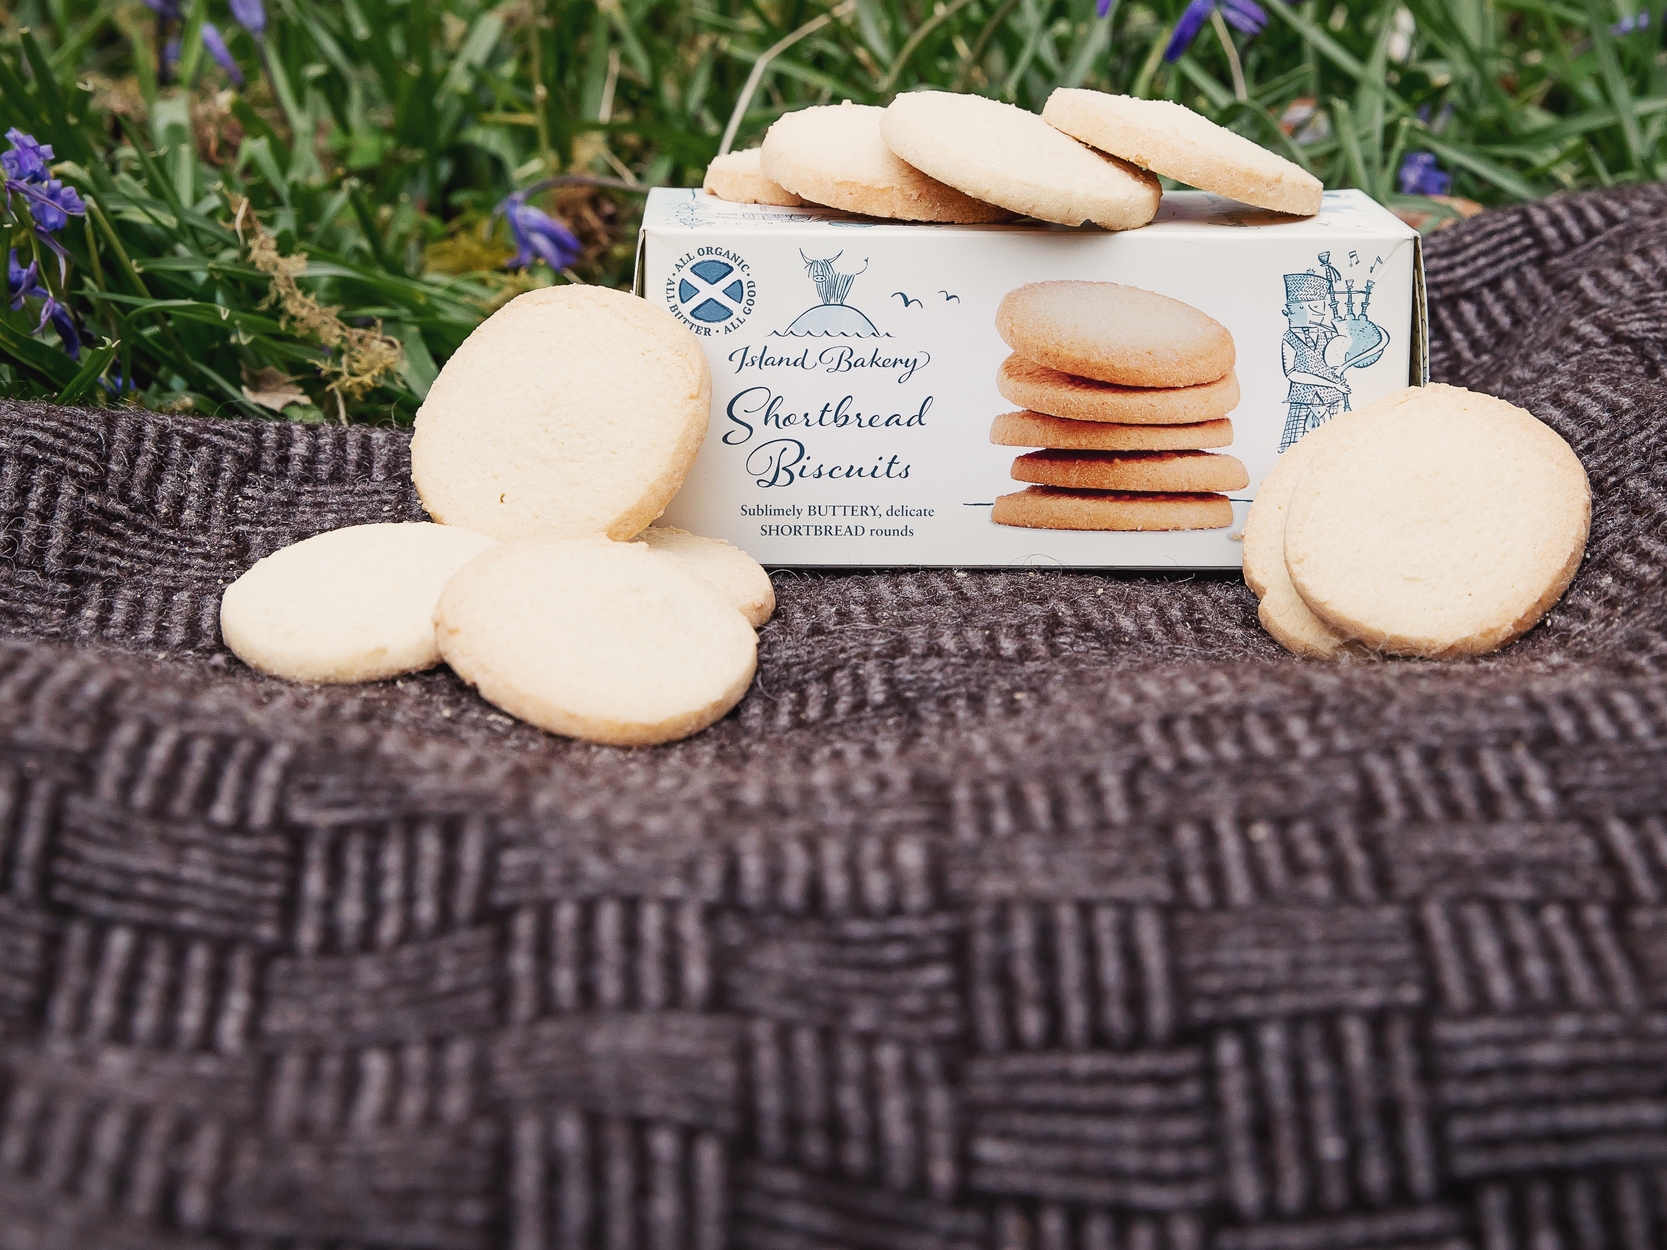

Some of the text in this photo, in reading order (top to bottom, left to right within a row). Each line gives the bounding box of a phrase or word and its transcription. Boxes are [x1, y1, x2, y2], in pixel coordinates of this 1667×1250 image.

[674, 246, 750, 273] ALL ORGANIC
[665, 277, 712, 337] ALL BUTTER
[724, 280, 757, 335] ALL GOOD
[728, 345, 931, 384] Island Bakery
[721, 386, 934, 446] Shortbread
[745, 438, 911, 488] Biscuits
[740, 504, 935, 520] Sublimely BUTTERY, delicate
[759, 524, 915, 537] SHORTBREAD rounds
